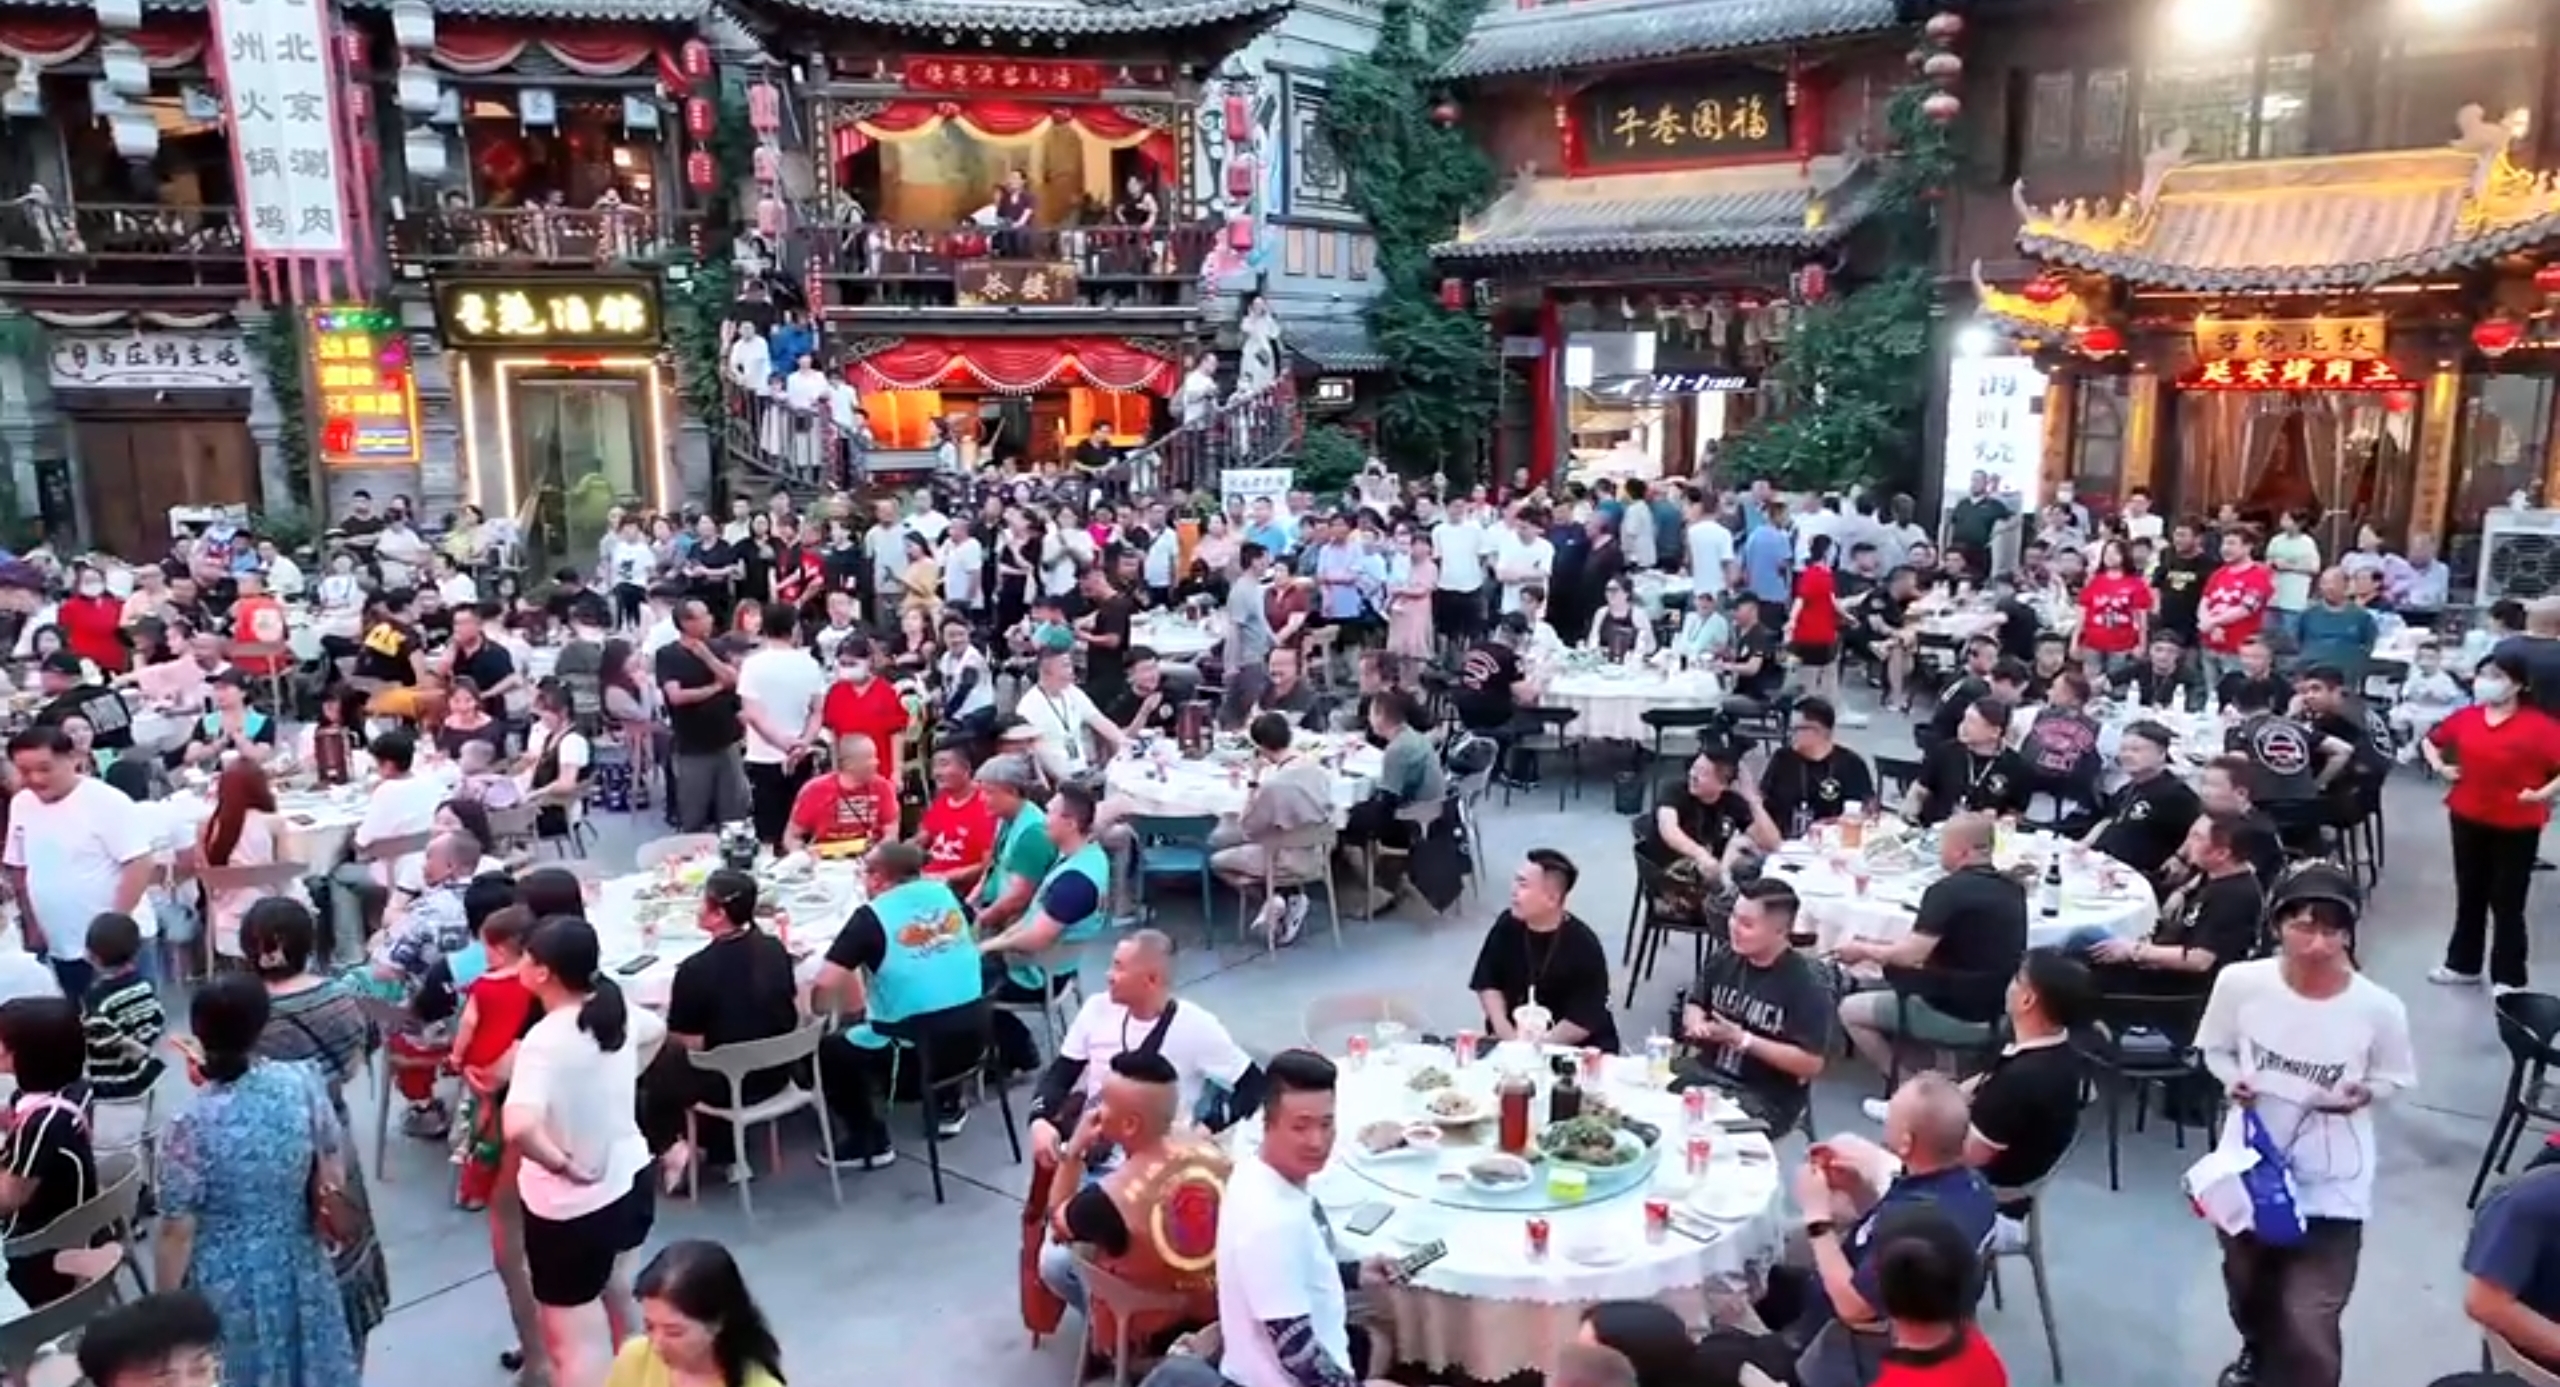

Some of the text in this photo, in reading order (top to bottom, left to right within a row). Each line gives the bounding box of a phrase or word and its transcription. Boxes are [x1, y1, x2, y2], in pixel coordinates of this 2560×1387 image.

[224, 0, 287, 236] 州火锅鸡
[276, 0, 335, 236] 北京涮肉
